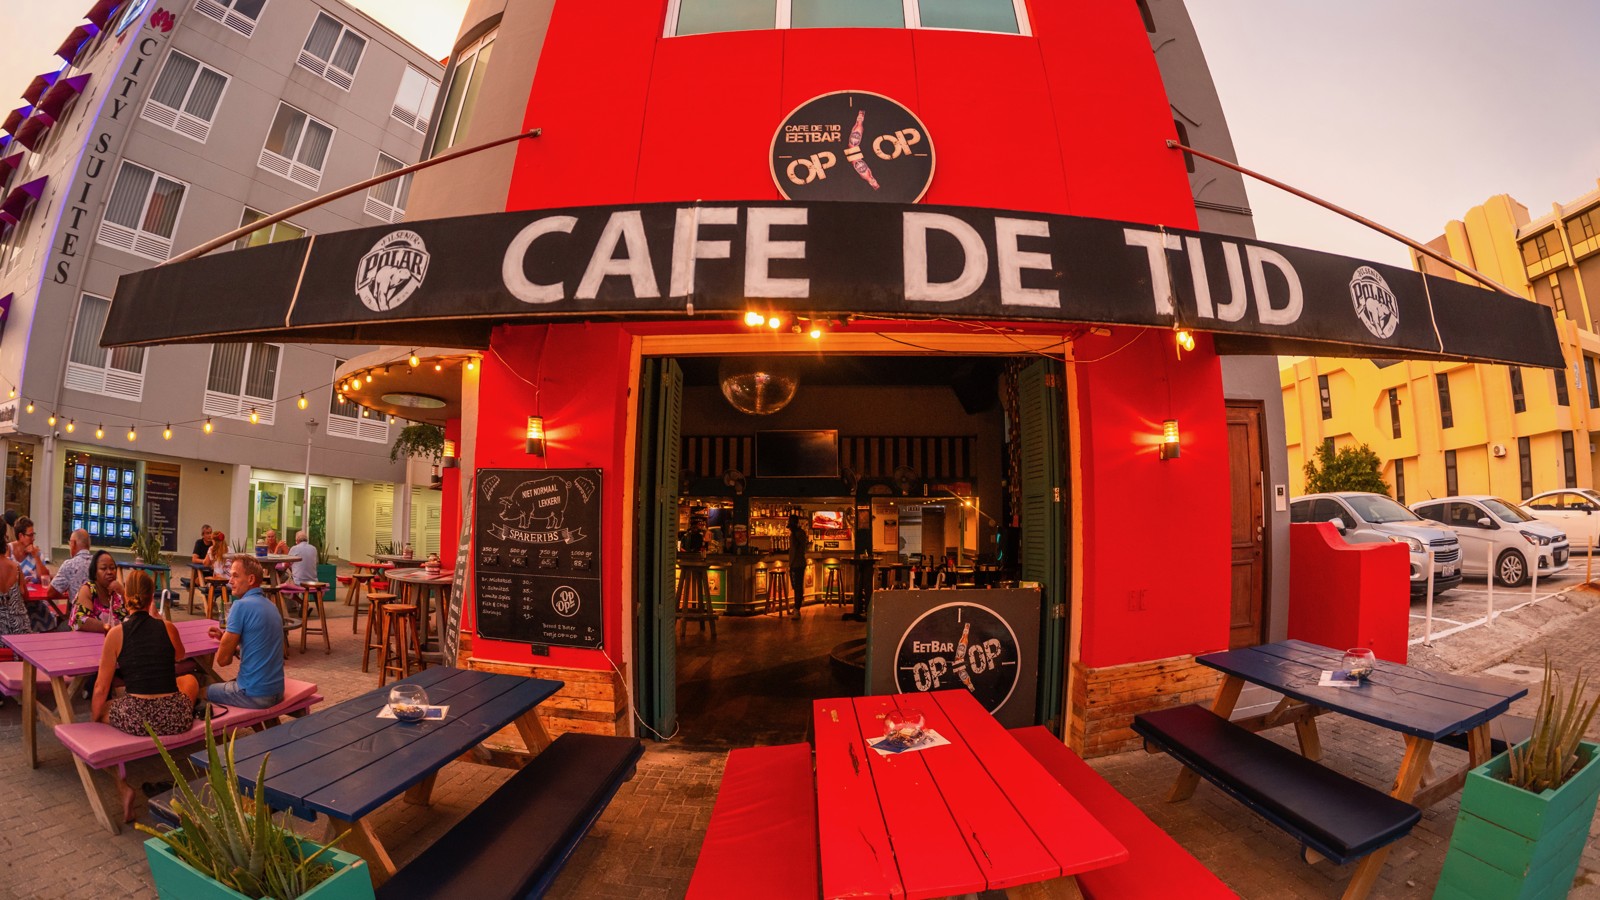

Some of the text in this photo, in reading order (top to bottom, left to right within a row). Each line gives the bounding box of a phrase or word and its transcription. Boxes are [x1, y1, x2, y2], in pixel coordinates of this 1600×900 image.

[110, 38, 158, 121] CITY
[786, 132, 841, 142] EETBAR
[872, 127, 922, 160] OP
[786, 151, 837, 185] OP
[53, 132, 112, 284] SUITES
[360, 250, 424, 285] POLAR
[502, 207, 1304, 326] CAFE DE TIJD
[1352, 282, 1396, 317] POLAR
[522, 484, 558, 498] NIET NORMAAL
[509, 530, 559, 542] SPARERIBS
[968, 638, 1002, 674] OP
[912, 656, 948, 692] OP
